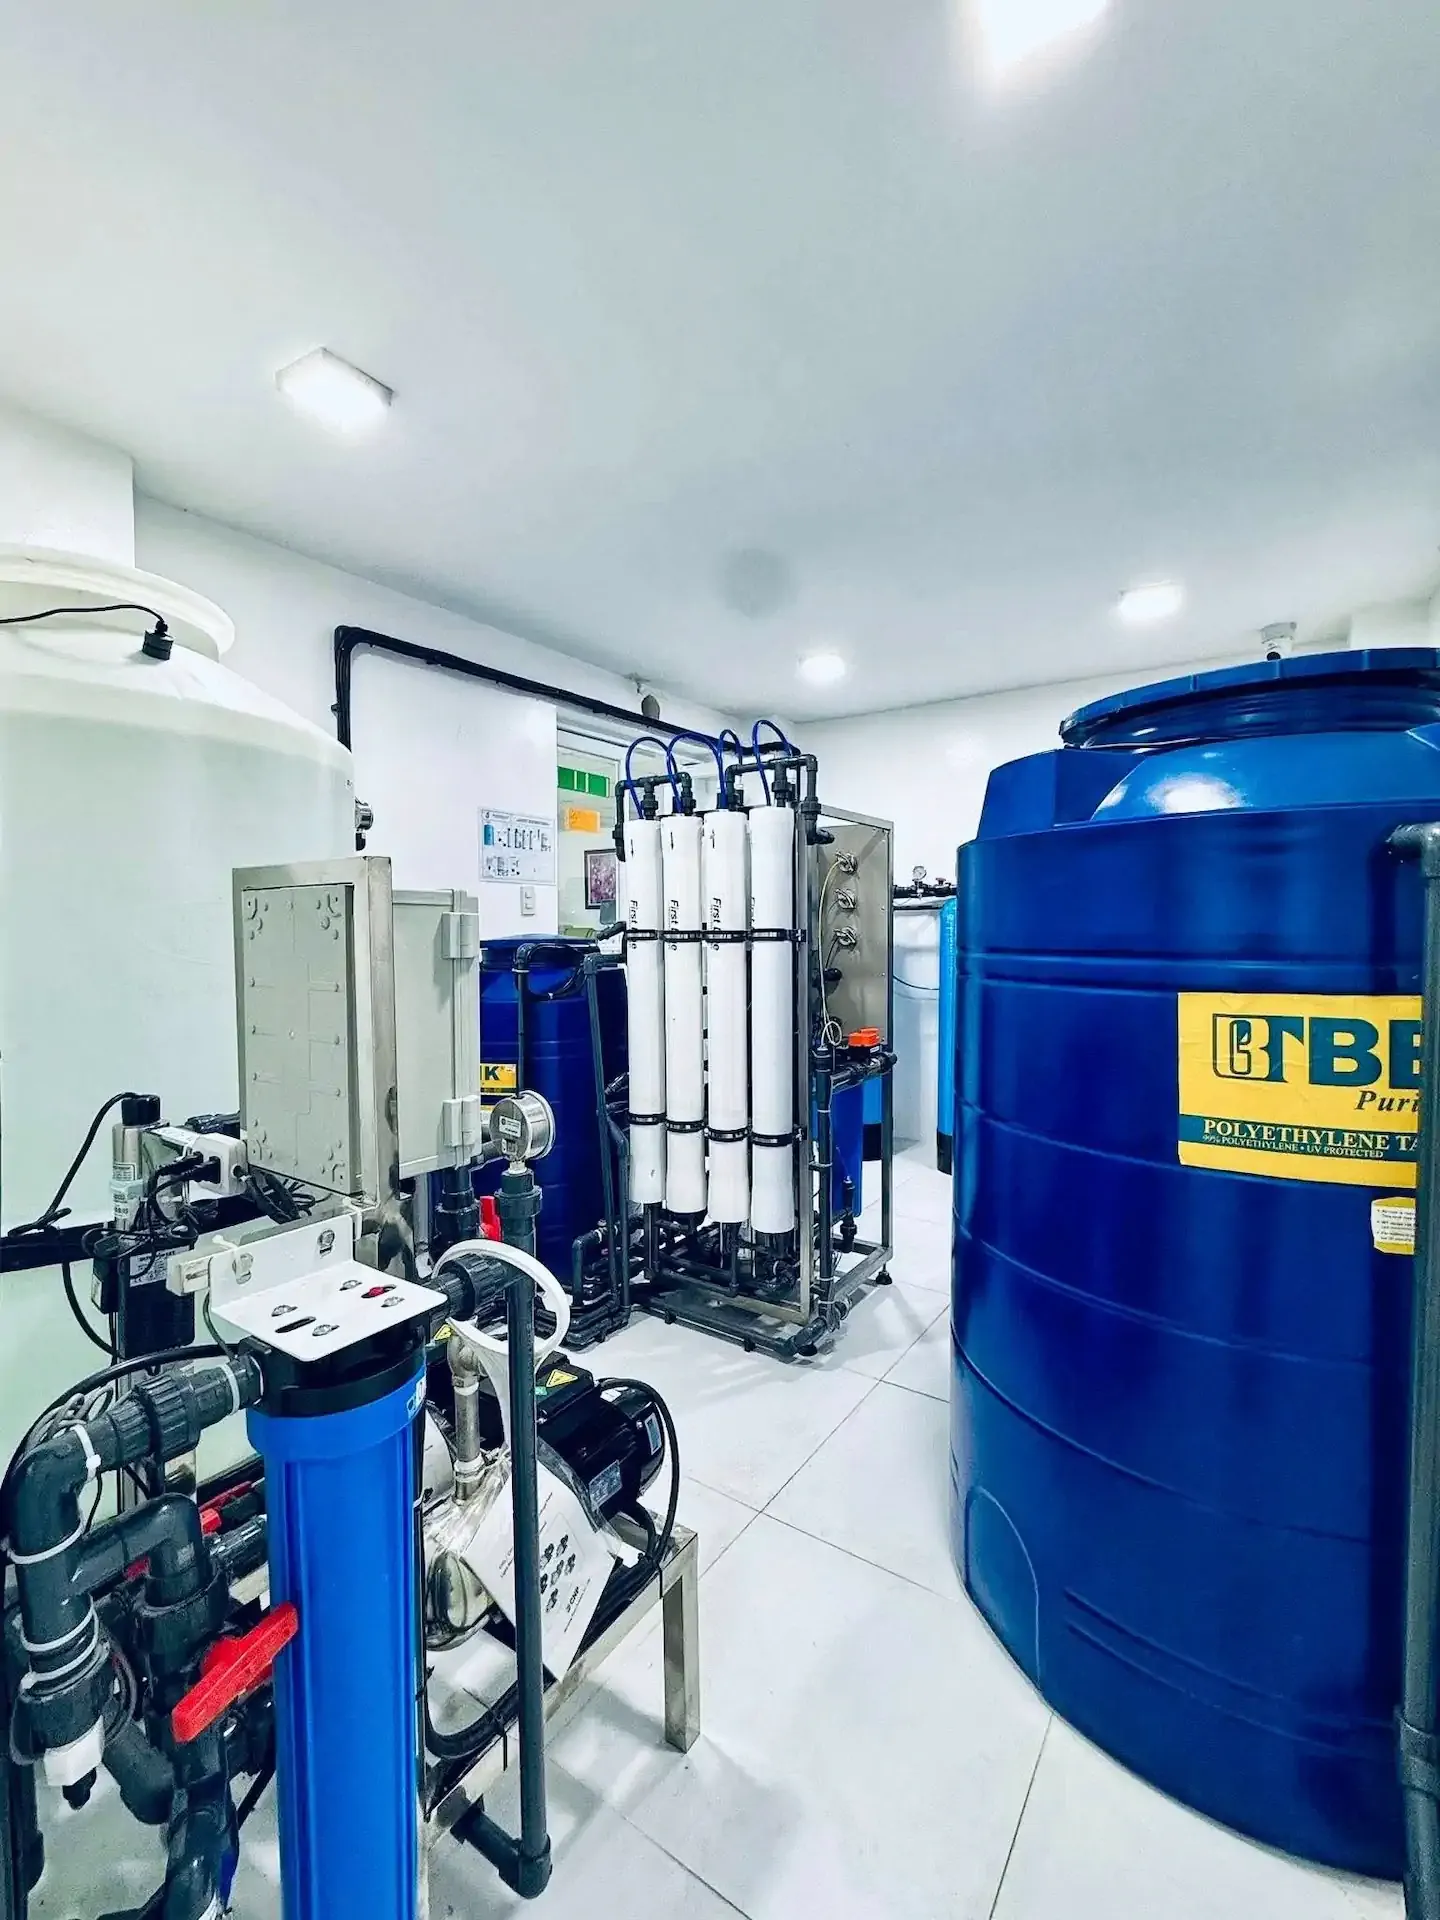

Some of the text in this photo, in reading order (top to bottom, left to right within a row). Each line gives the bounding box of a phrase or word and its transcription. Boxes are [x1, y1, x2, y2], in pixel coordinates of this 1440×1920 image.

[1203, 1118, 1390, 1151] POLYETHYLENE
[1221, 1136, 1298, 1153] POLYETHYLENE
[1323, 1146, 1384, 1159] PROTECTED
